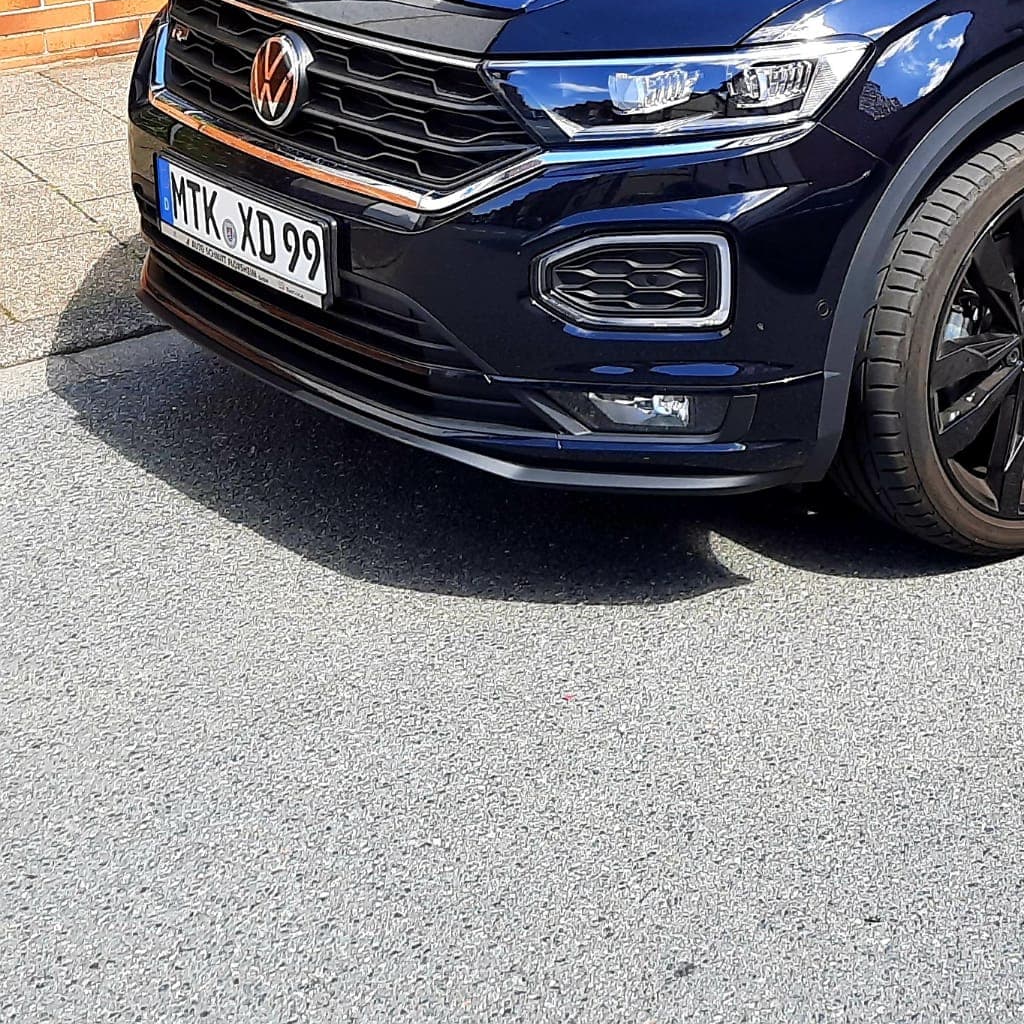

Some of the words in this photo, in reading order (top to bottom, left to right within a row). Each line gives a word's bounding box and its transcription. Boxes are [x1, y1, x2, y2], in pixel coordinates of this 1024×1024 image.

[171, 171, 221, 241] MTK
[238, 201, 277, 264] XD
[282, 222, 322, 281] 99
